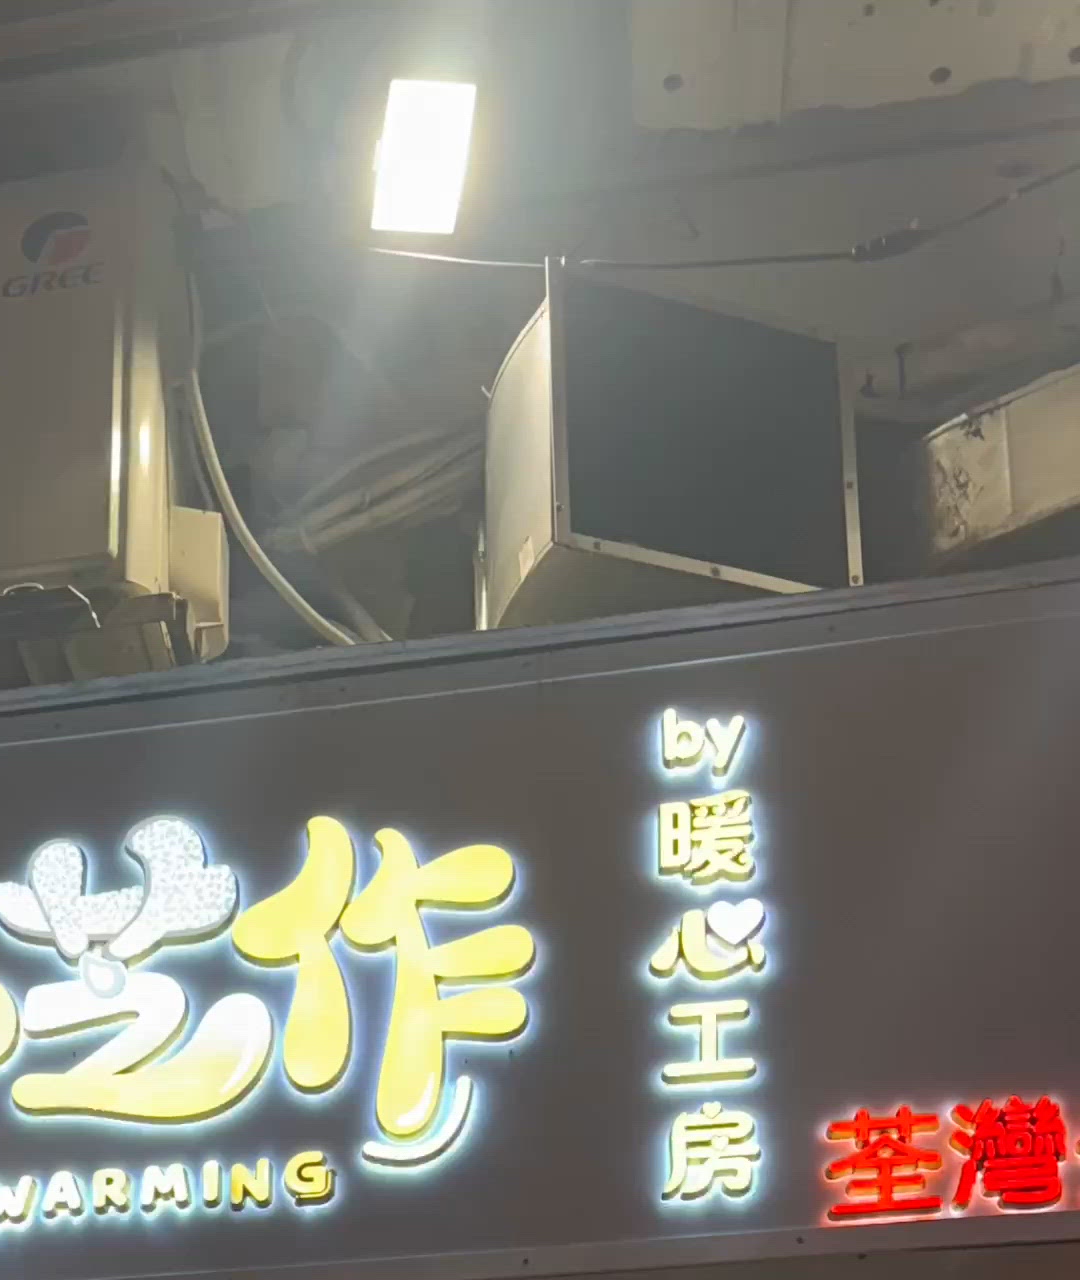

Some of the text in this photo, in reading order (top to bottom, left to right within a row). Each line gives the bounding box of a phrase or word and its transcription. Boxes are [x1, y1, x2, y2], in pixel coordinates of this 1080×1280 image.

[658, 707, 747, 778] by
[648, 787, 768, 1203] 暖心工房
